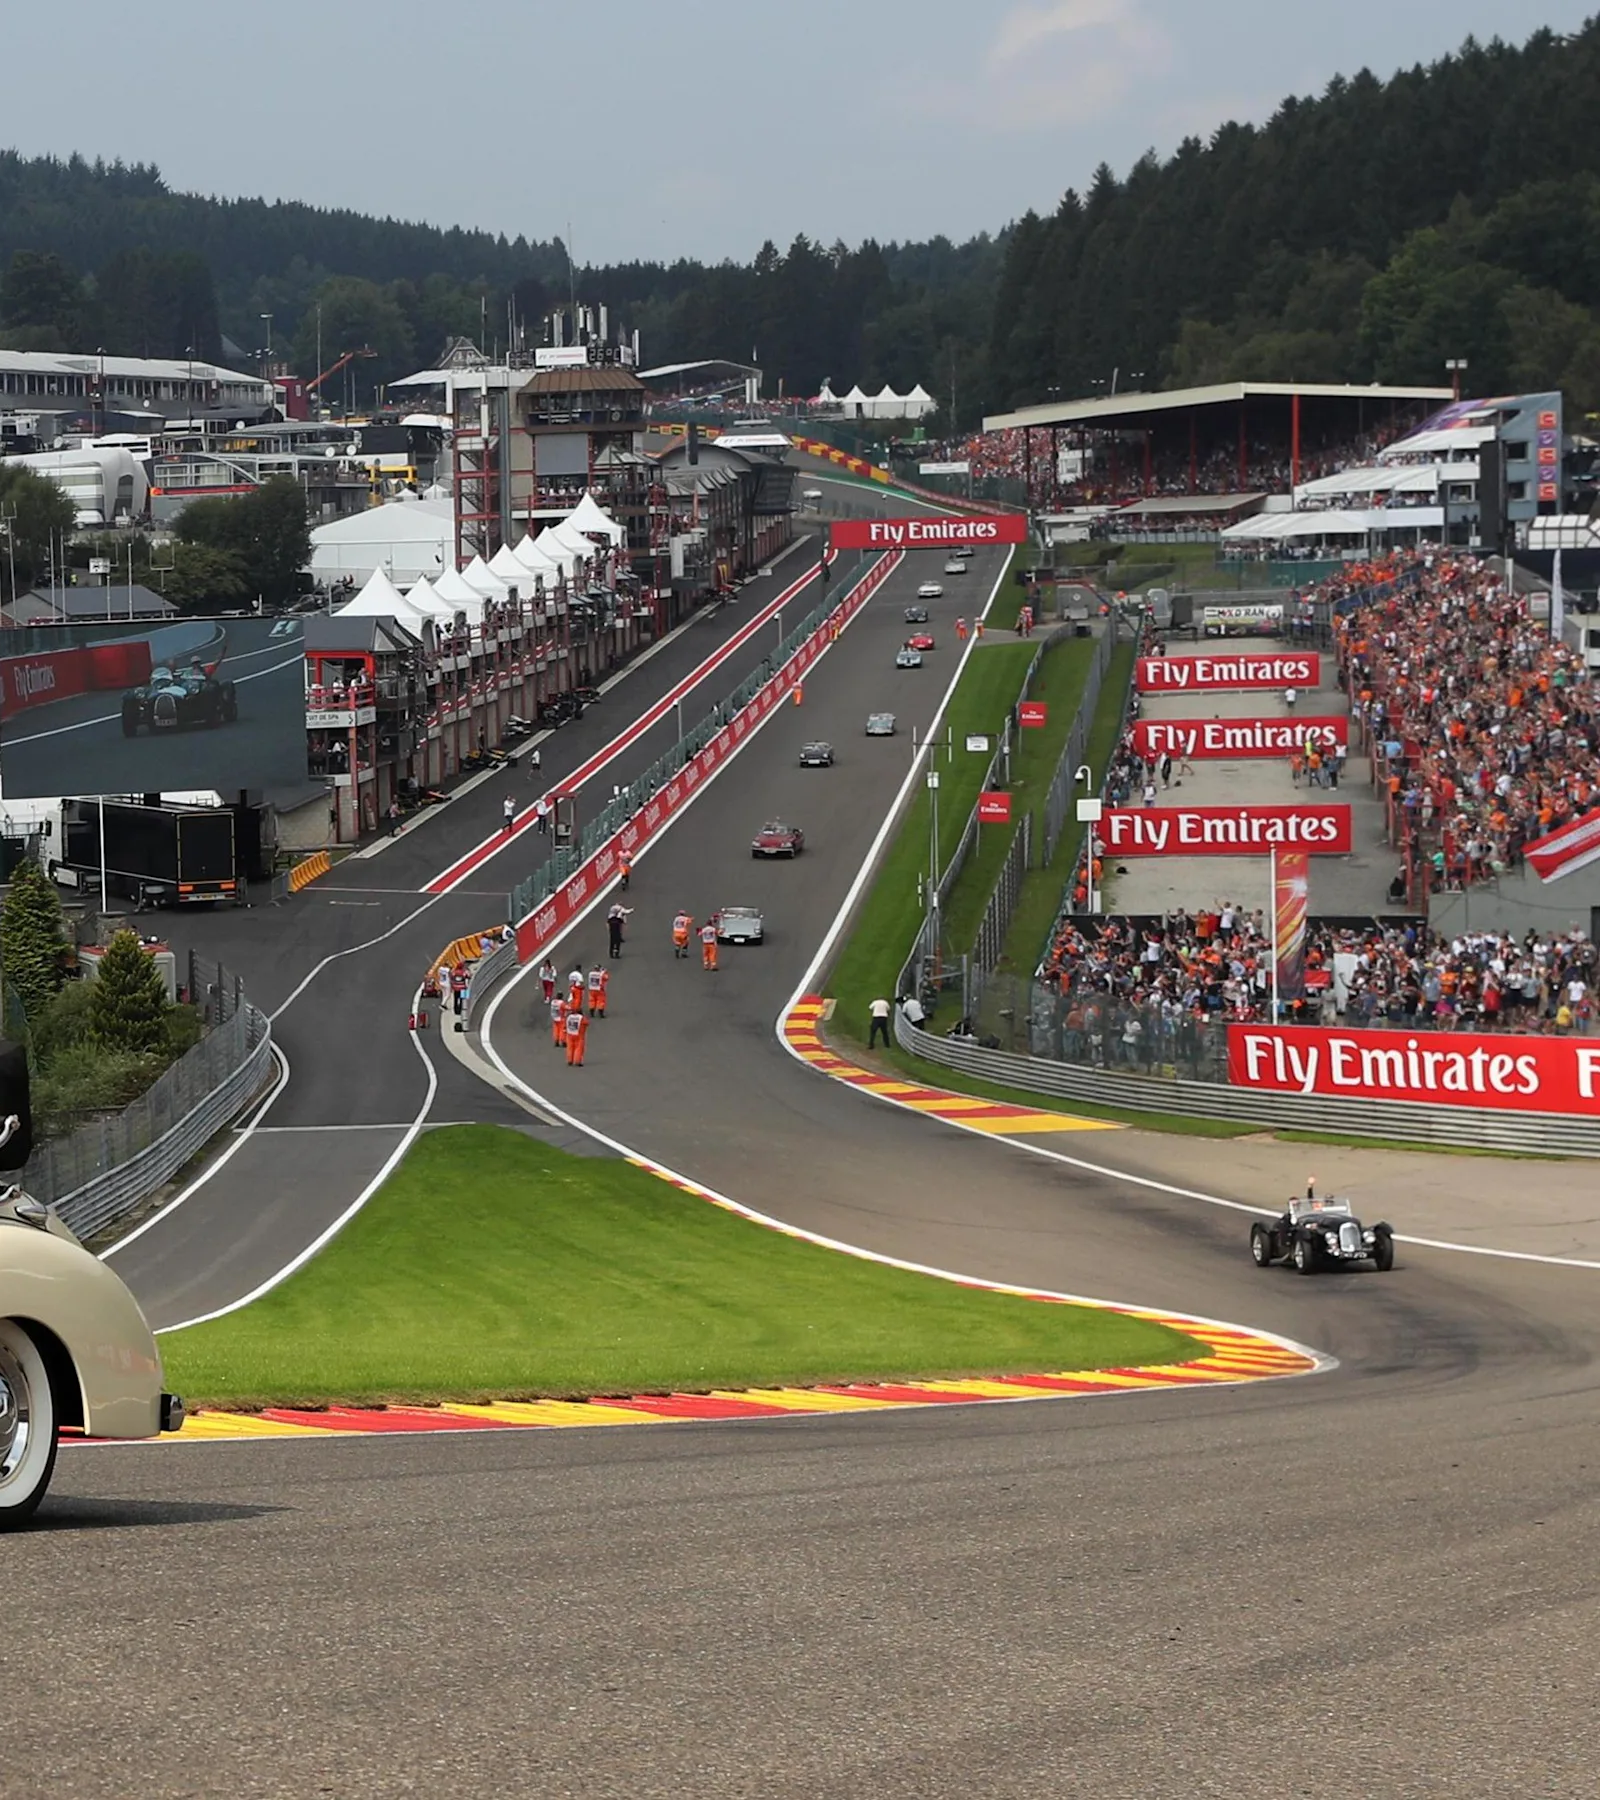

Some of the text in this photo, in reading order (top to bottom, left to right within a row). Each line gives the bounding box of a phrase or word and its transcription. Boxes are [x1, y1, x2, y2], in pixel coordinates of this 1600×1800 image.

[870, 519, 998, 544] Fly Emirates
[14, 661, 56, 702] Fly Emirates
[1146, 658, 1310, 687] Fly Emirates
[1146, 722, 1337, 755] Fly Emirates
[1109, 811, 1338, 850] Fly Emirates
[1244, 1035, 1318, 1094] Fly
[1328, 1038, 1540, 1095] Emirates
